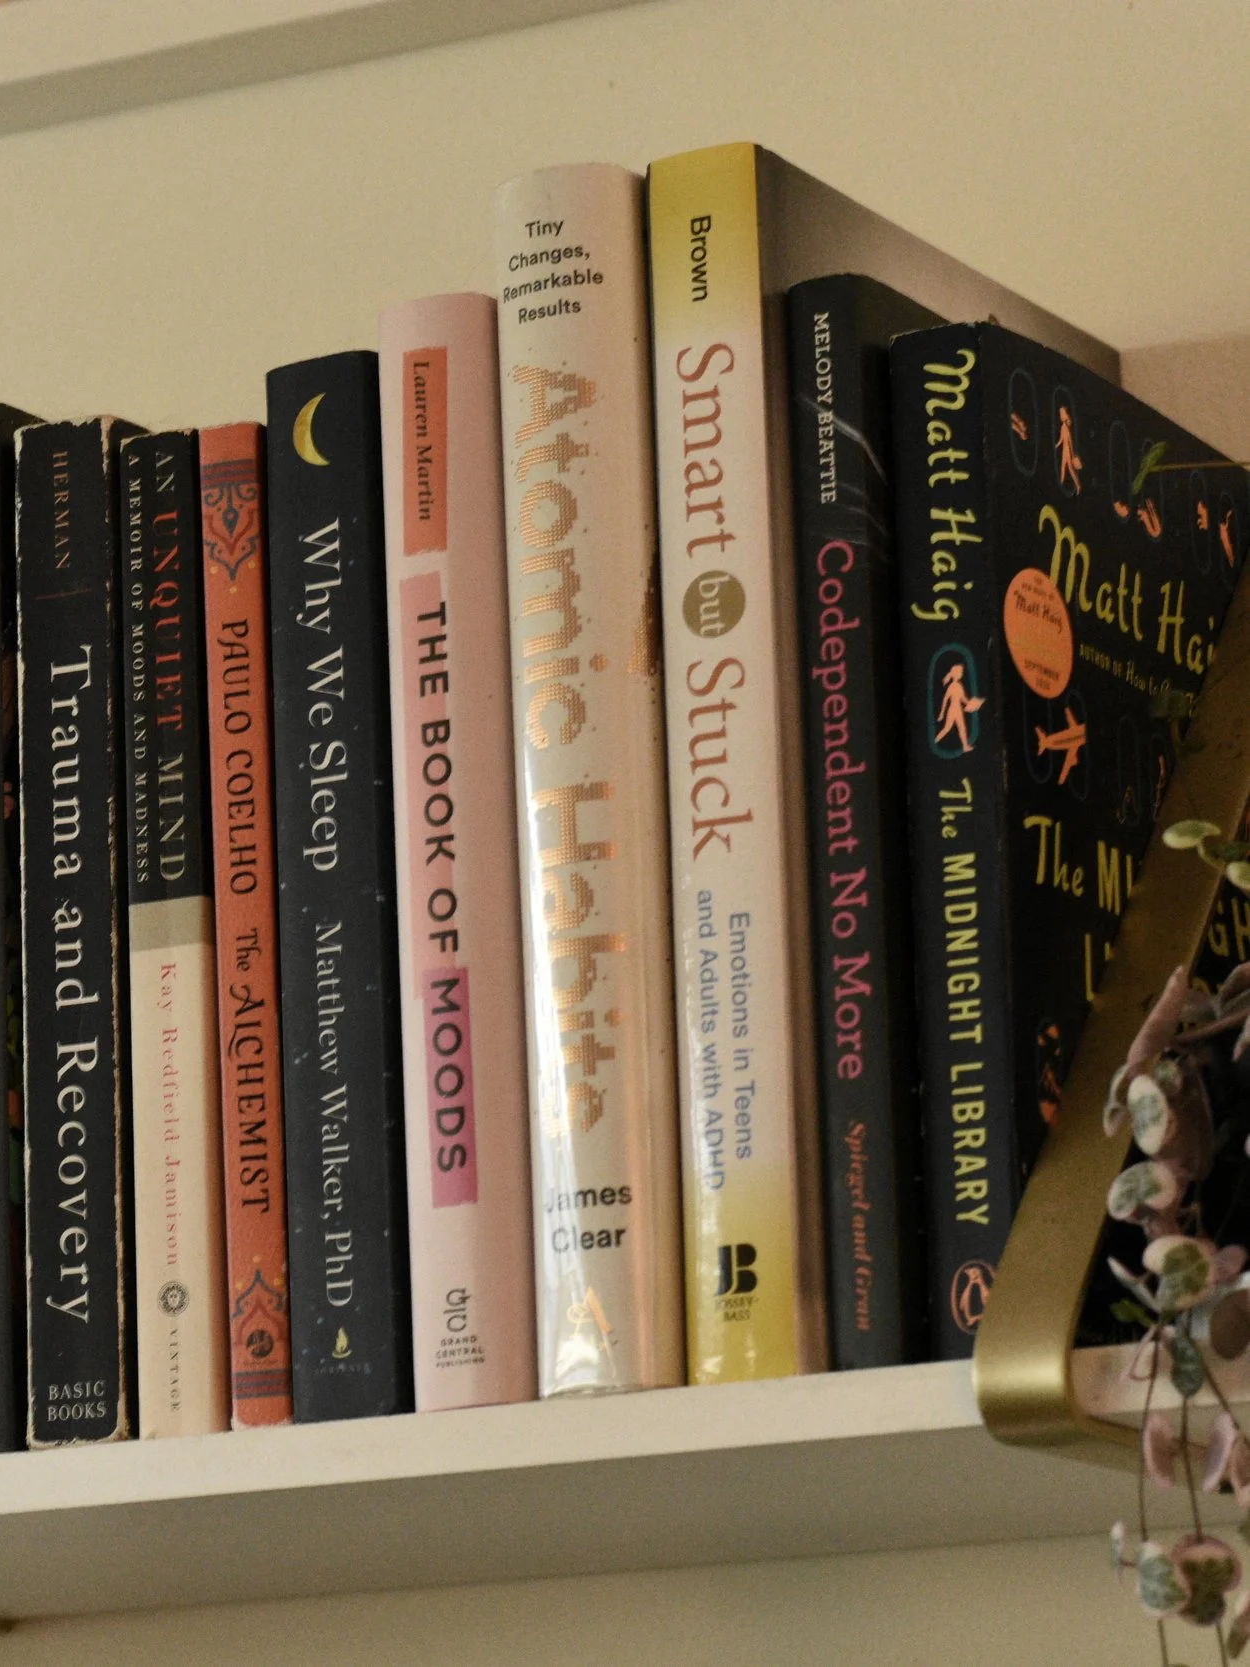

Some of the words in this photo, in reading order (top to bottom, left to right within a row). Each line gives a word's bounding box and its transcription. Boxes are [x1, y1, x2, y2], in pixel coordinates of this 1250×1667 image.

[508, 244, 591, 272] Changes,
[525, 220, 565, 240] Tiny
[690, 214, 712, 302] Brown
[503, 267, 604, 304] Remarkable
[518, 300, 582, 325] Results
[413, 361, 432, 438] Lauren
[814, 311, 833, 404] MELODY
[129, 455, 140, 466] A
[675, 343, 737, 559] Smart
[817, 411, 838, 505] BEATTIE
[922, 348, 977, 489] Matt
[52, 450, 71, 569] HERMAN
[155, 451, 175, 493] AN
[416, 445, 435, 522] Martin
[129, 479, 143, 572] MEMOIR
[511, 364, 608, 751] Atomic
[910, 507, 984, 621] Haig
[131, 583, 143, 611] OF
[296, 517, 342, 635] Why
[697, 575, 731, 635] but
[1037, 503, 1143, 642] Matt
[132, 623, 146, 702] MOODS
[150, 509, 184, 731] UNQUIET
[417, 601, 449, 698] THE
[217, 618, 252, 734] PAULO
[306, 645, 345, 729] We
[812, 538, 868, 856] Codependent
[50, 642, 93, 880] Trauma
[134, 714, 147, 760] AND
[686, 657, 754, 862] Stuck
[135, 772, 150, 883] MADNESS
[157, 752, 186, 882] MIND
[226, 750, 258, 895] COELHO
[303, 740, 348, 871] Sleep
[421, 718, 456, 866] BOOK
[938, 777, 974, 839] The
[1023, 815, 1085, 897] The
[426, 888, 459, 954] OF
[696, 889, 713, 940] and
[830, 867, 869, 939] No
[53, 901, 100, 1011] and
[157, 963, 177, 1013] Kay
[236, 927, 261, 973] The
[531, 780, 627, 1140] Habits
[699, 949, 719, 1035] Adults
[729, 910, 751, 1040] Emotions
[943, 853, 983, 1045] MIDNIGHT
[315, 920, 346, 1075] Matthew
[833, 951, 873, 1080] More
[161, 1027, 181, 1143] Redfield
[228, 983, 270, 1214] ALCHEMIST
[430, 977, 467, 1173] MOODS
[702, 1041, 721, 1100] with
[733, 1047, 752, 1075] in
[319, 1084, 350, 1220] Walker,
[703, 1111, 727, 1193] ADHD
[735, 1080, 756, 1160] Teens
[950, 1061, 990, 1227] LIBRARY
[46, 1036, 99, 1324] Recovery
[546, 1184, 633, 1213] James
[845, 1120, 872, 1211] Spiegel
[165, 1155, 181, 1266] Jamison
[551, 1226, 627, 1253] Clear
[853, 1213, 873, 1263] and
[324, 1229, 355, 1308] PhD
[168, 1328, 182, 1413] VINTAGE
[435, 1346, 485, 1359] CENTRAL
[440, 1335, 478, 1347] GRAND
[47, 1401, 107, 1422] BOOKS
[49, 1380, 105, 1400] BASIC
